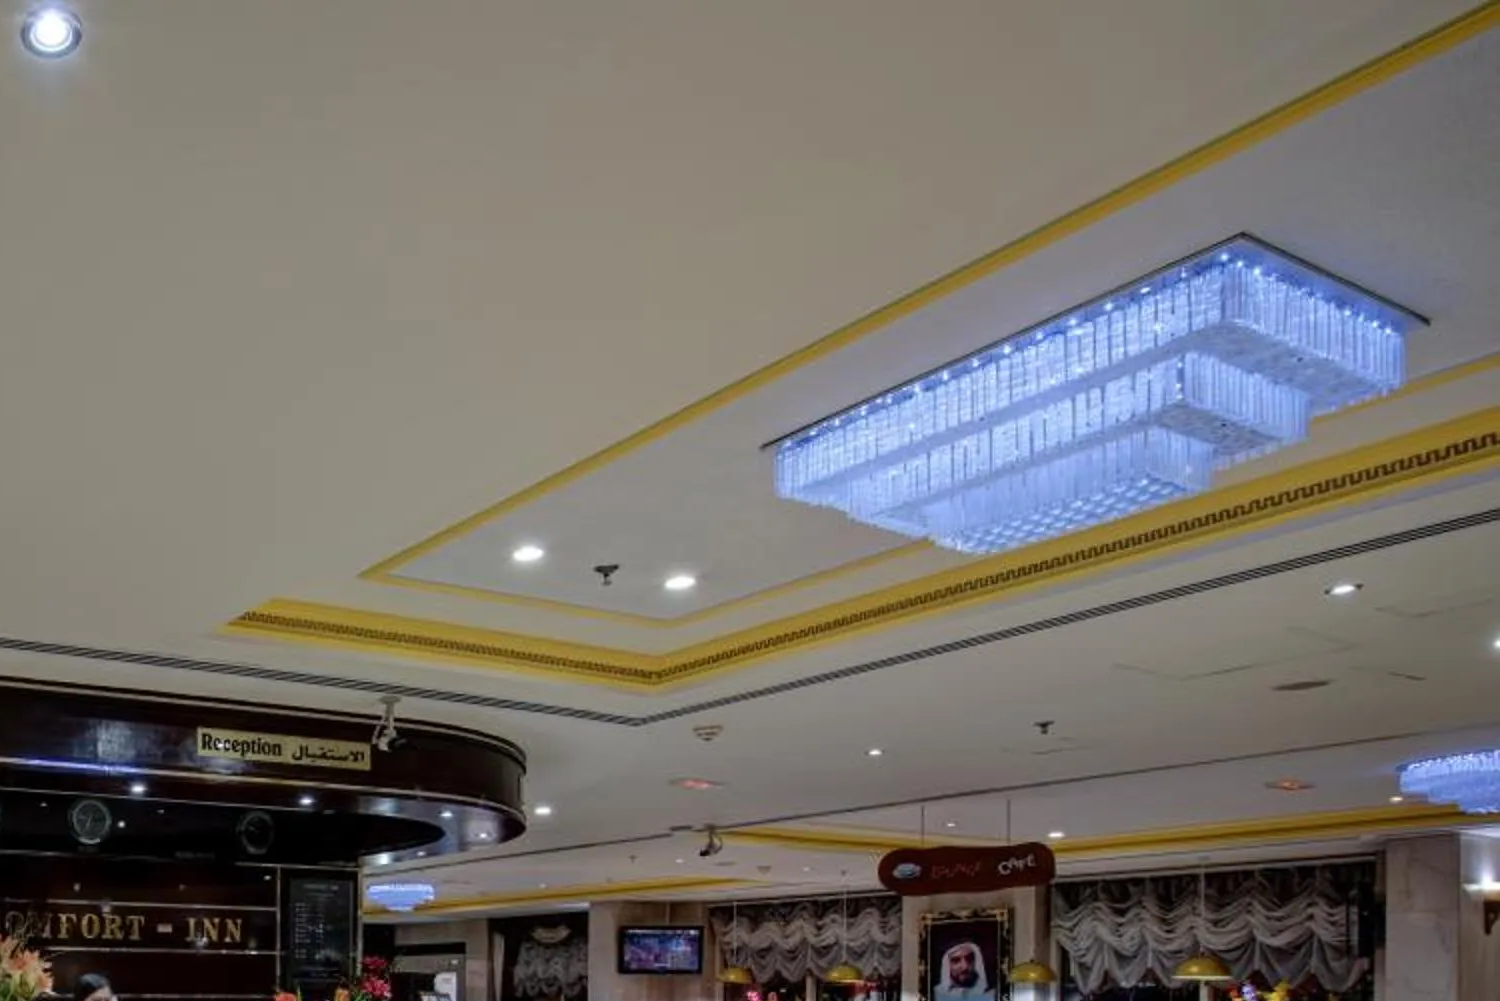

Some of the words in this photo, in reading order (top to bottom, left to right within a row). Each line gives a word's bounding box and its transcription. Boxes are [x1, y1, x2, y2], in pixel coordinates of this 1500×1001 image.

[201, 733, 283, 757] Reception
[292, 744, 365, 763] الاستقبال
[184, 916, 243, 943] INN
